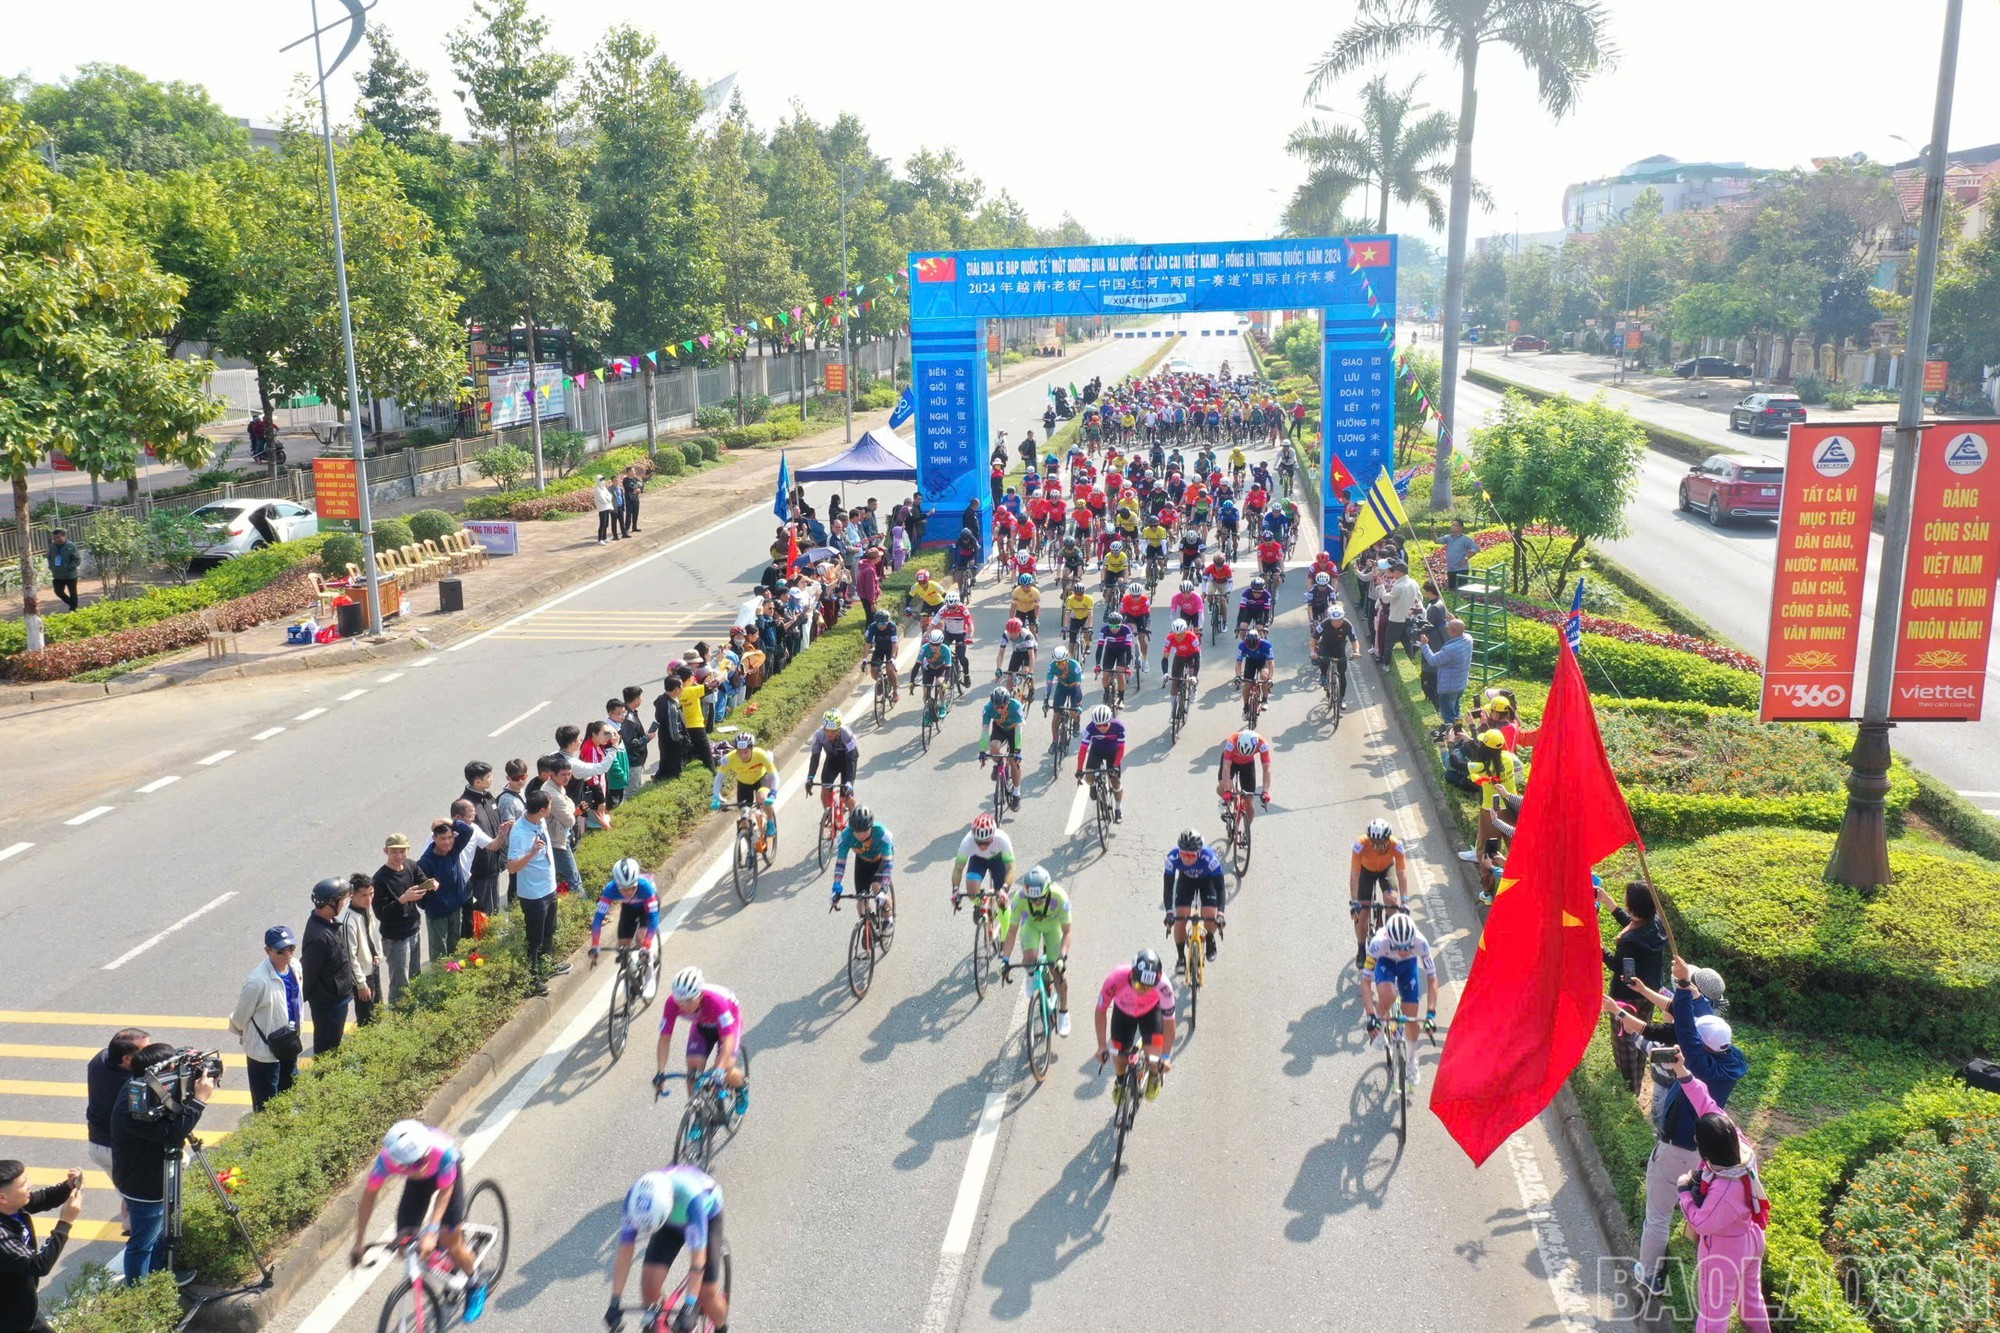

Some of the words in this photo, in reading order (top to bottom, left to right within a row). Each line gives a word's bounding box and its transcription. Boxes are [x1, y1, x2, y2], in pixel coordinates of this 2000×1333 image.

[996, 260, 1004, 275] XE
[1006, 260, 1019, 278] ĐẠP
[1020, 255, 1038, 276] QUỐC
[1107, 256, 1119, 272] HAI
[1120, 251, 1138, 273] QUỐC
[1169, 255, 1181, 270] CAI
[1200, 253, 1219, 269] NAM)
[1256, 251, 1282, 268] (TRUNG
[1283, 245, 1304, 267] QUỐC)
[1306, 247, 1323, 265] NĂM
[1324, 248, 1342, 264] 2024
[1341, 358, 1363, 366] GIAO
[928, 367, 947, 376] BIÊN
[956, 397, 965, 405] 友
[957, 426, 967, 434] 万
[958, 440, 967, 449] 古
[1345, 449, 1358, 457] LAI
[958, 455, 968, 464] 兴
[1802, 484, 1824, 502] TẤT
[1826, 483, 1842, 502] CẢ
[1846, 484, 1858, 502] VÌ
[1942, 481, 1979, 508] ĐẢNG
[1799, 512, 1827, 529] MỤC
[1830, 508, 1856, 526] TIÊU
[484, 526, 492, 534] THI
[494, 524, 509, 534] CÔNG
[1924, 518, 1959, 546] CỘNG
[1962, 515, 1990, 541] SẢN
[1795, 532, 1820, 549] DÂN
[1822, 532, 1854, 550] GIÀU,
[1784, 556, 1817, 572] NƯỚC
[1820, 558, 1859, 575] MẠNH,
[1923, 552, 1950, 579] VIỆT
[1952, 555, 1983, 574] NAM
[1792, 578, 1816, 595] DÂN
[1820, 576, 1846, 596] CHỦ,
[1911, 588, 1954, 609] QUANG
[1957, 588, 1987, 607] VINH
[1781, 602, 1814, 618] CÔNG
[1784, 624, 1807, 640] VĂN
[1810, 626, 1846, 640] MINH!
[1907, 616, 1946, 640] MUÔN
[1948, 617, 1983, 640] NĂM!
[1900, 684, 1976, 699] viettel
